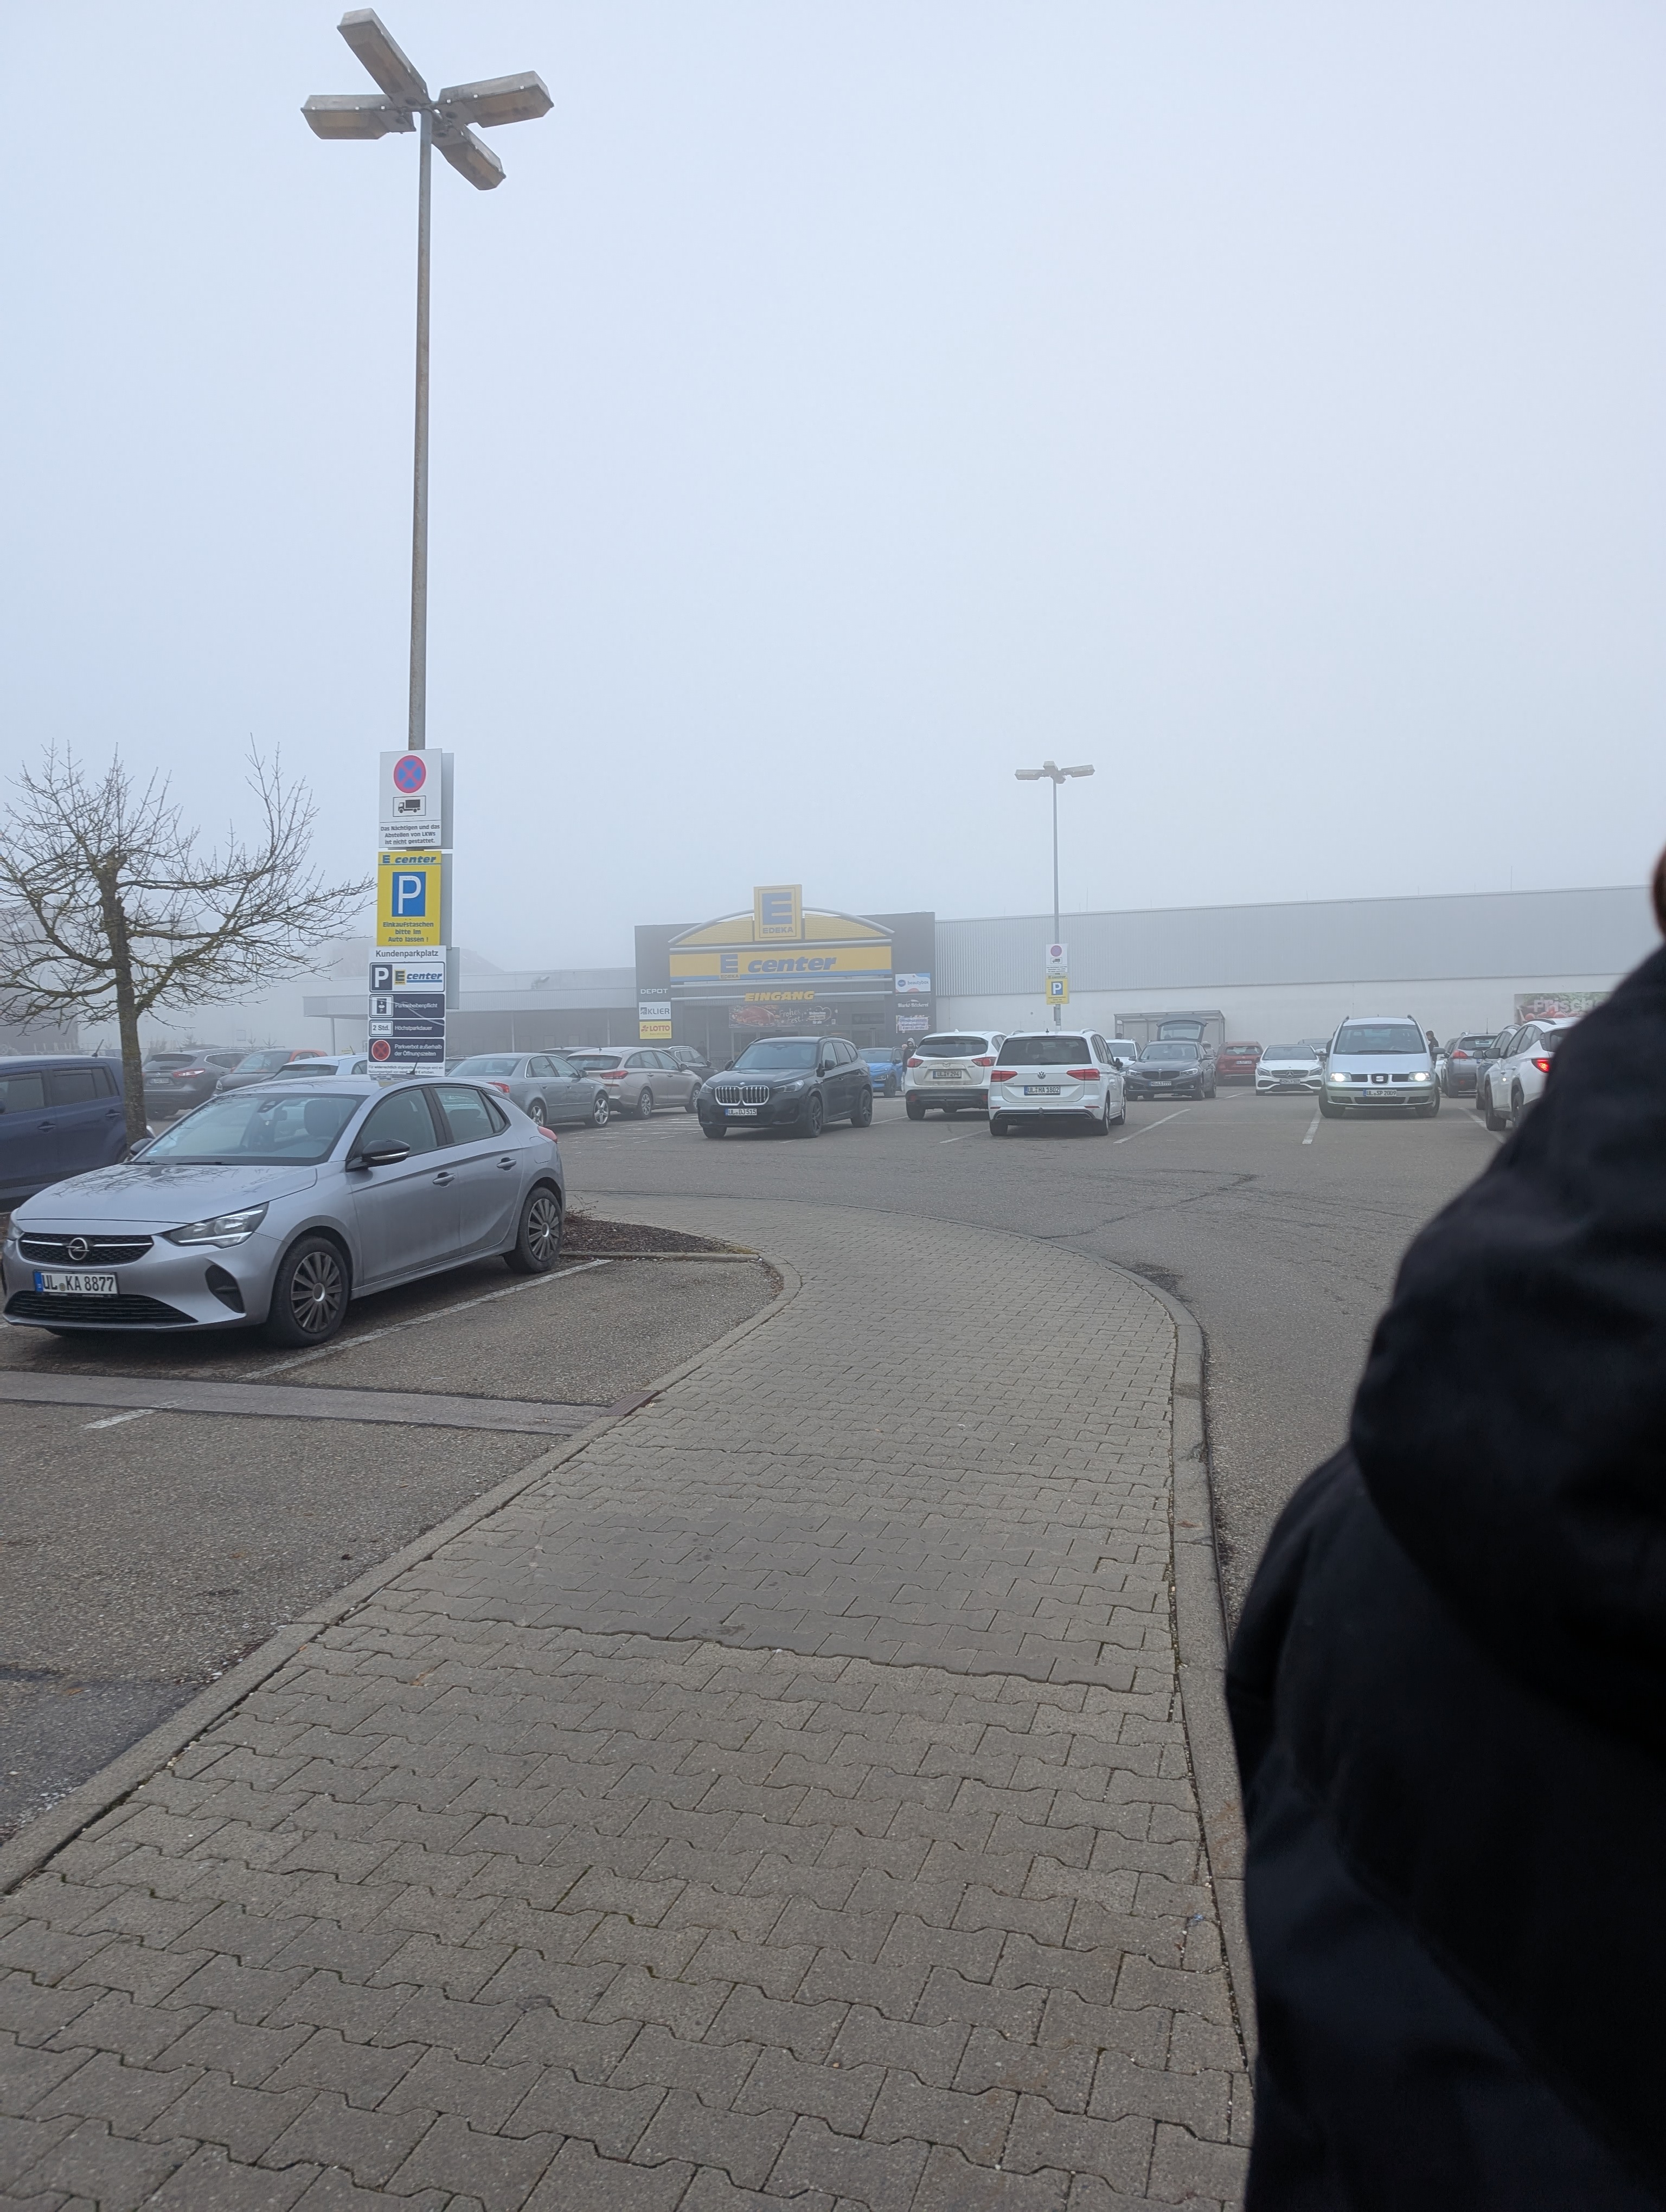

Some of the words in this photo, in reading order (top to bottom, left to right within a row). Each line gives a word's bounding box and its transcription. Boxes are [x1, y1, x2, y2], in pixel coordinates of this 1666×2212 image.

[382, 855, 390, 863] E
[398, 875, 421, 914] P
[762, 892, 792, 925] E
[376, 950, 439, 959] Kundenparkplatz
[720, 954, 738, 973] E
[748, 956, 837, 973] center
[375, 967, 389, 988] P
[395, 971, 405, 981] E
[1053, 982, 1061, 994] P
[744, 991, 815, 1002] EINGANG
[780, 1008, 800, 1017] Frohes
[42, 1275, 57, 1290] UL
[66, 1276, 82, 1291] KA
[85, 1276, 114, 1291] 8877
